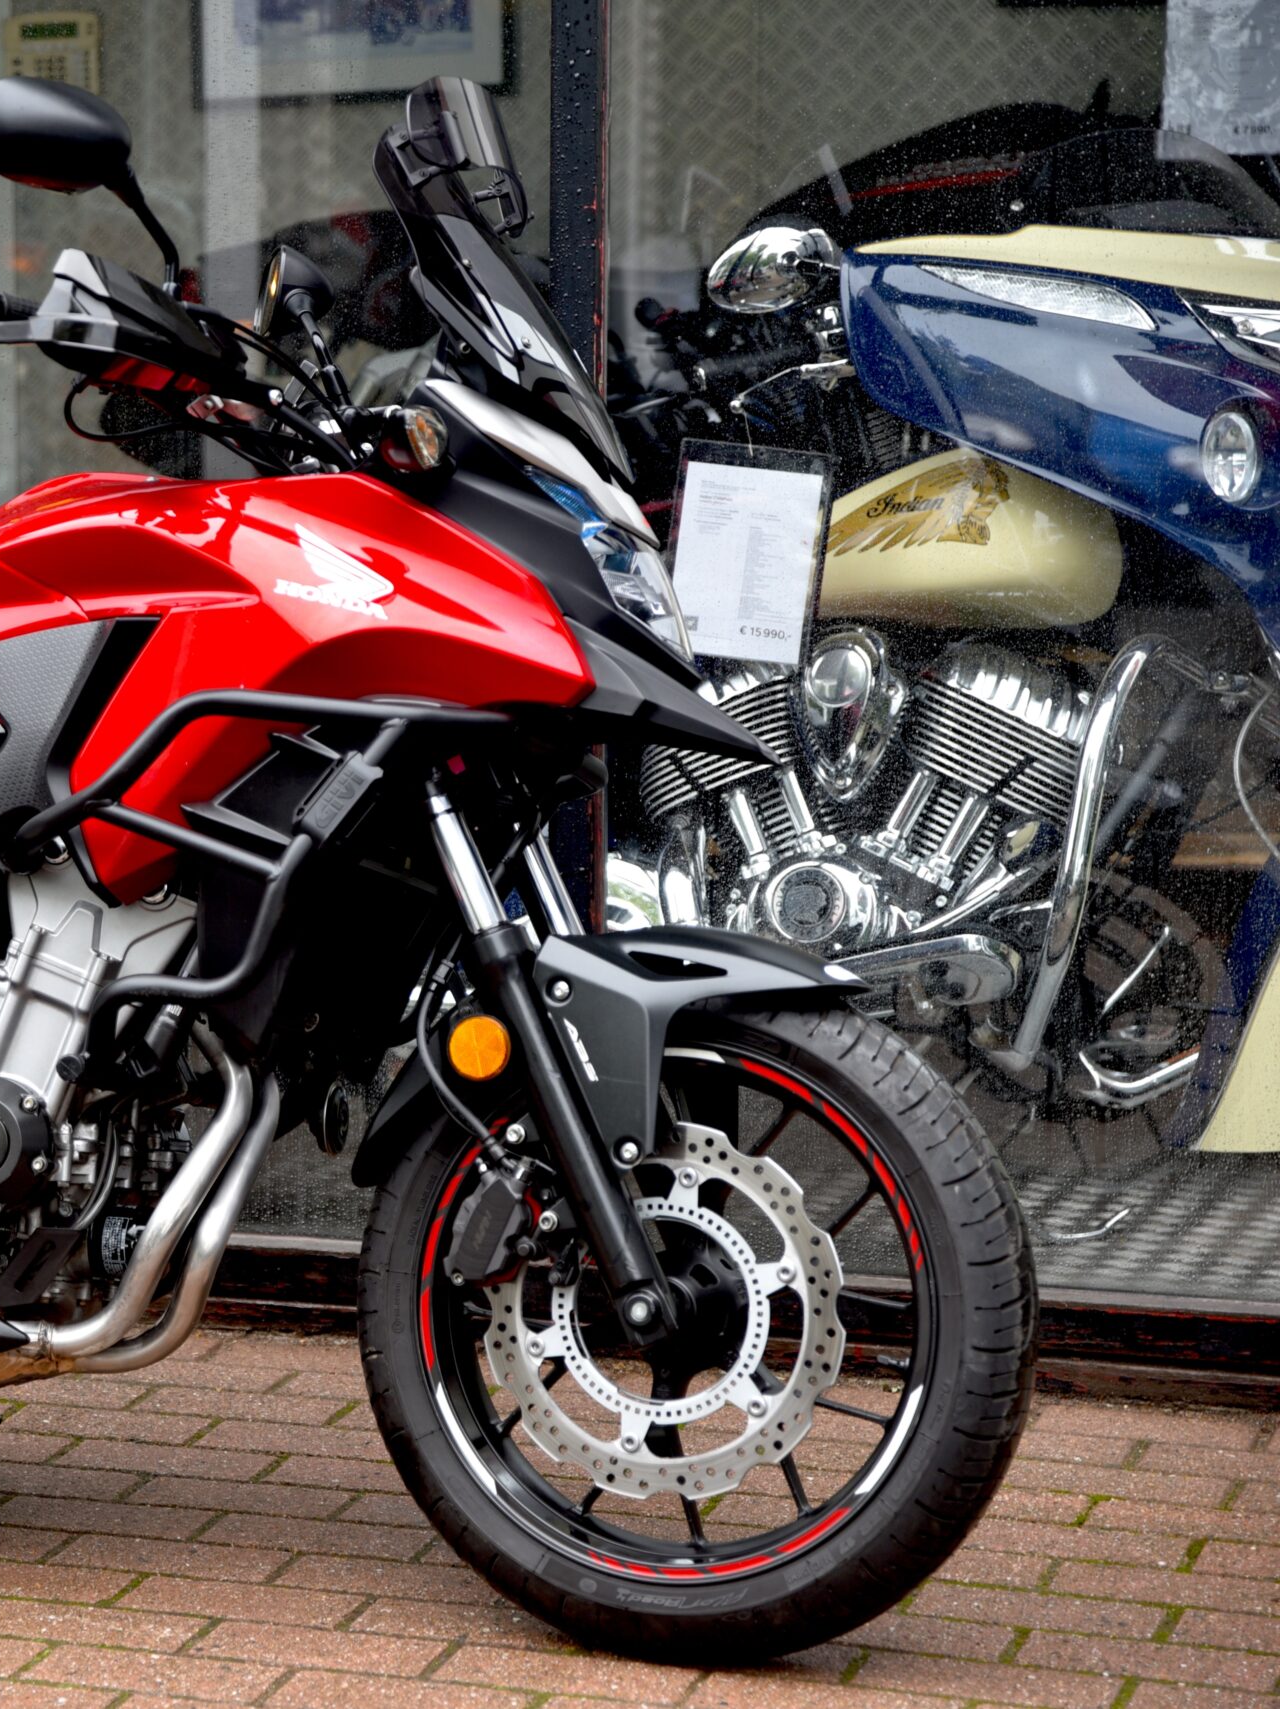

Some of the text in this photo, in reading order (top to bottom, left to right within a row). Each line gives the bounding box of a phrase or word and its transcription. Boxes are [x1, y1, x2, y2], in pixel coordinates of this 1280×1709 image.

[866, 493, 945, 518] Indian
[273, 578, 388, 620] HONDA
[740, 625, 747, 636] €
[315, 772, 367, 829] GIVI
[563, 1017, 599, 1082] ABS
